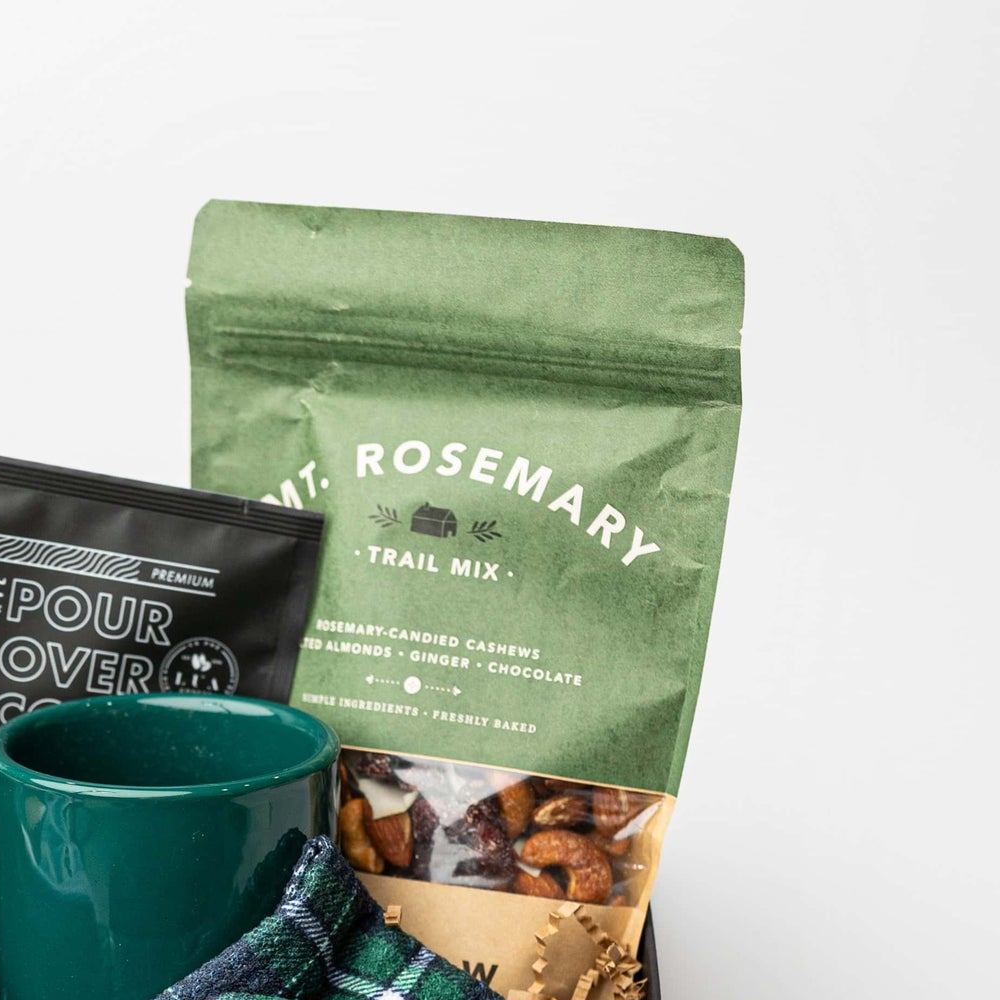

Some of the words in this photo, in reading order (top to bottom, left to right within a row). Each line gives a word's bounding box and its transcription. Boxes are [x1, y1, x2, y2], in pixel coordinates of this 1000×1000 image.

[356, 440, 661, 567] ROSEMARY
[151, 567, 215, 588] PREMIUM
[367, 545, 439, 573] TRAIL
[450, 557, 500, 581] MIX
[6, 578, 173, 646] POUR
[325, 640, 392, 658] ALMONDS
[410, 650, 470, 669] GINGER
[488, 661, 582, 687] CHOCOLATE
[466, 639, 541, 660] CASHEWS
[339, 698, 419, 717] INGREDIENTS
[432, 710, 489, 727] FRESHLY
[494, 719, 537, 734] BAKED
